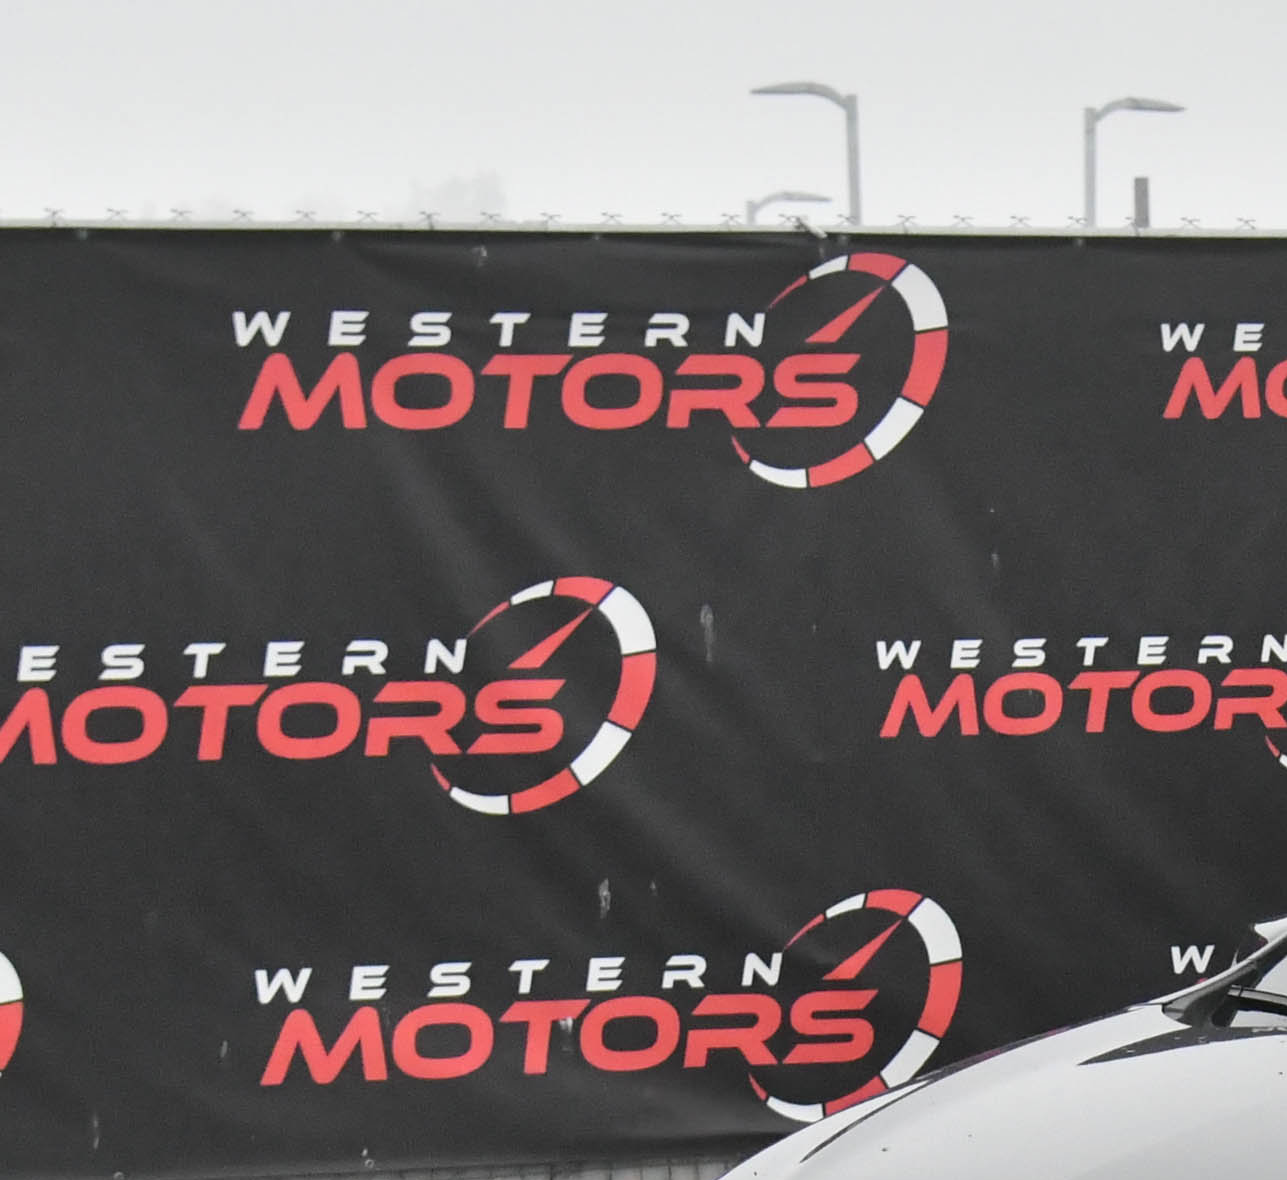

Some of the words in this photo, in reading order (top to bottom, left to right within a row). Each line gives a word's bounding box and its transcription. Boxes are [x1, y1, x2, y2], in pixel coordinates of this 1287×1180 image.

[232, 311, 766, 348] WESTERN
[238, 352, 861, 431] MOTORS
[17, 638, 467, 683] ESTERN
[254, 952, 783, 1005] WESTERN
[260, 988, 879, 1087] MOTORS
